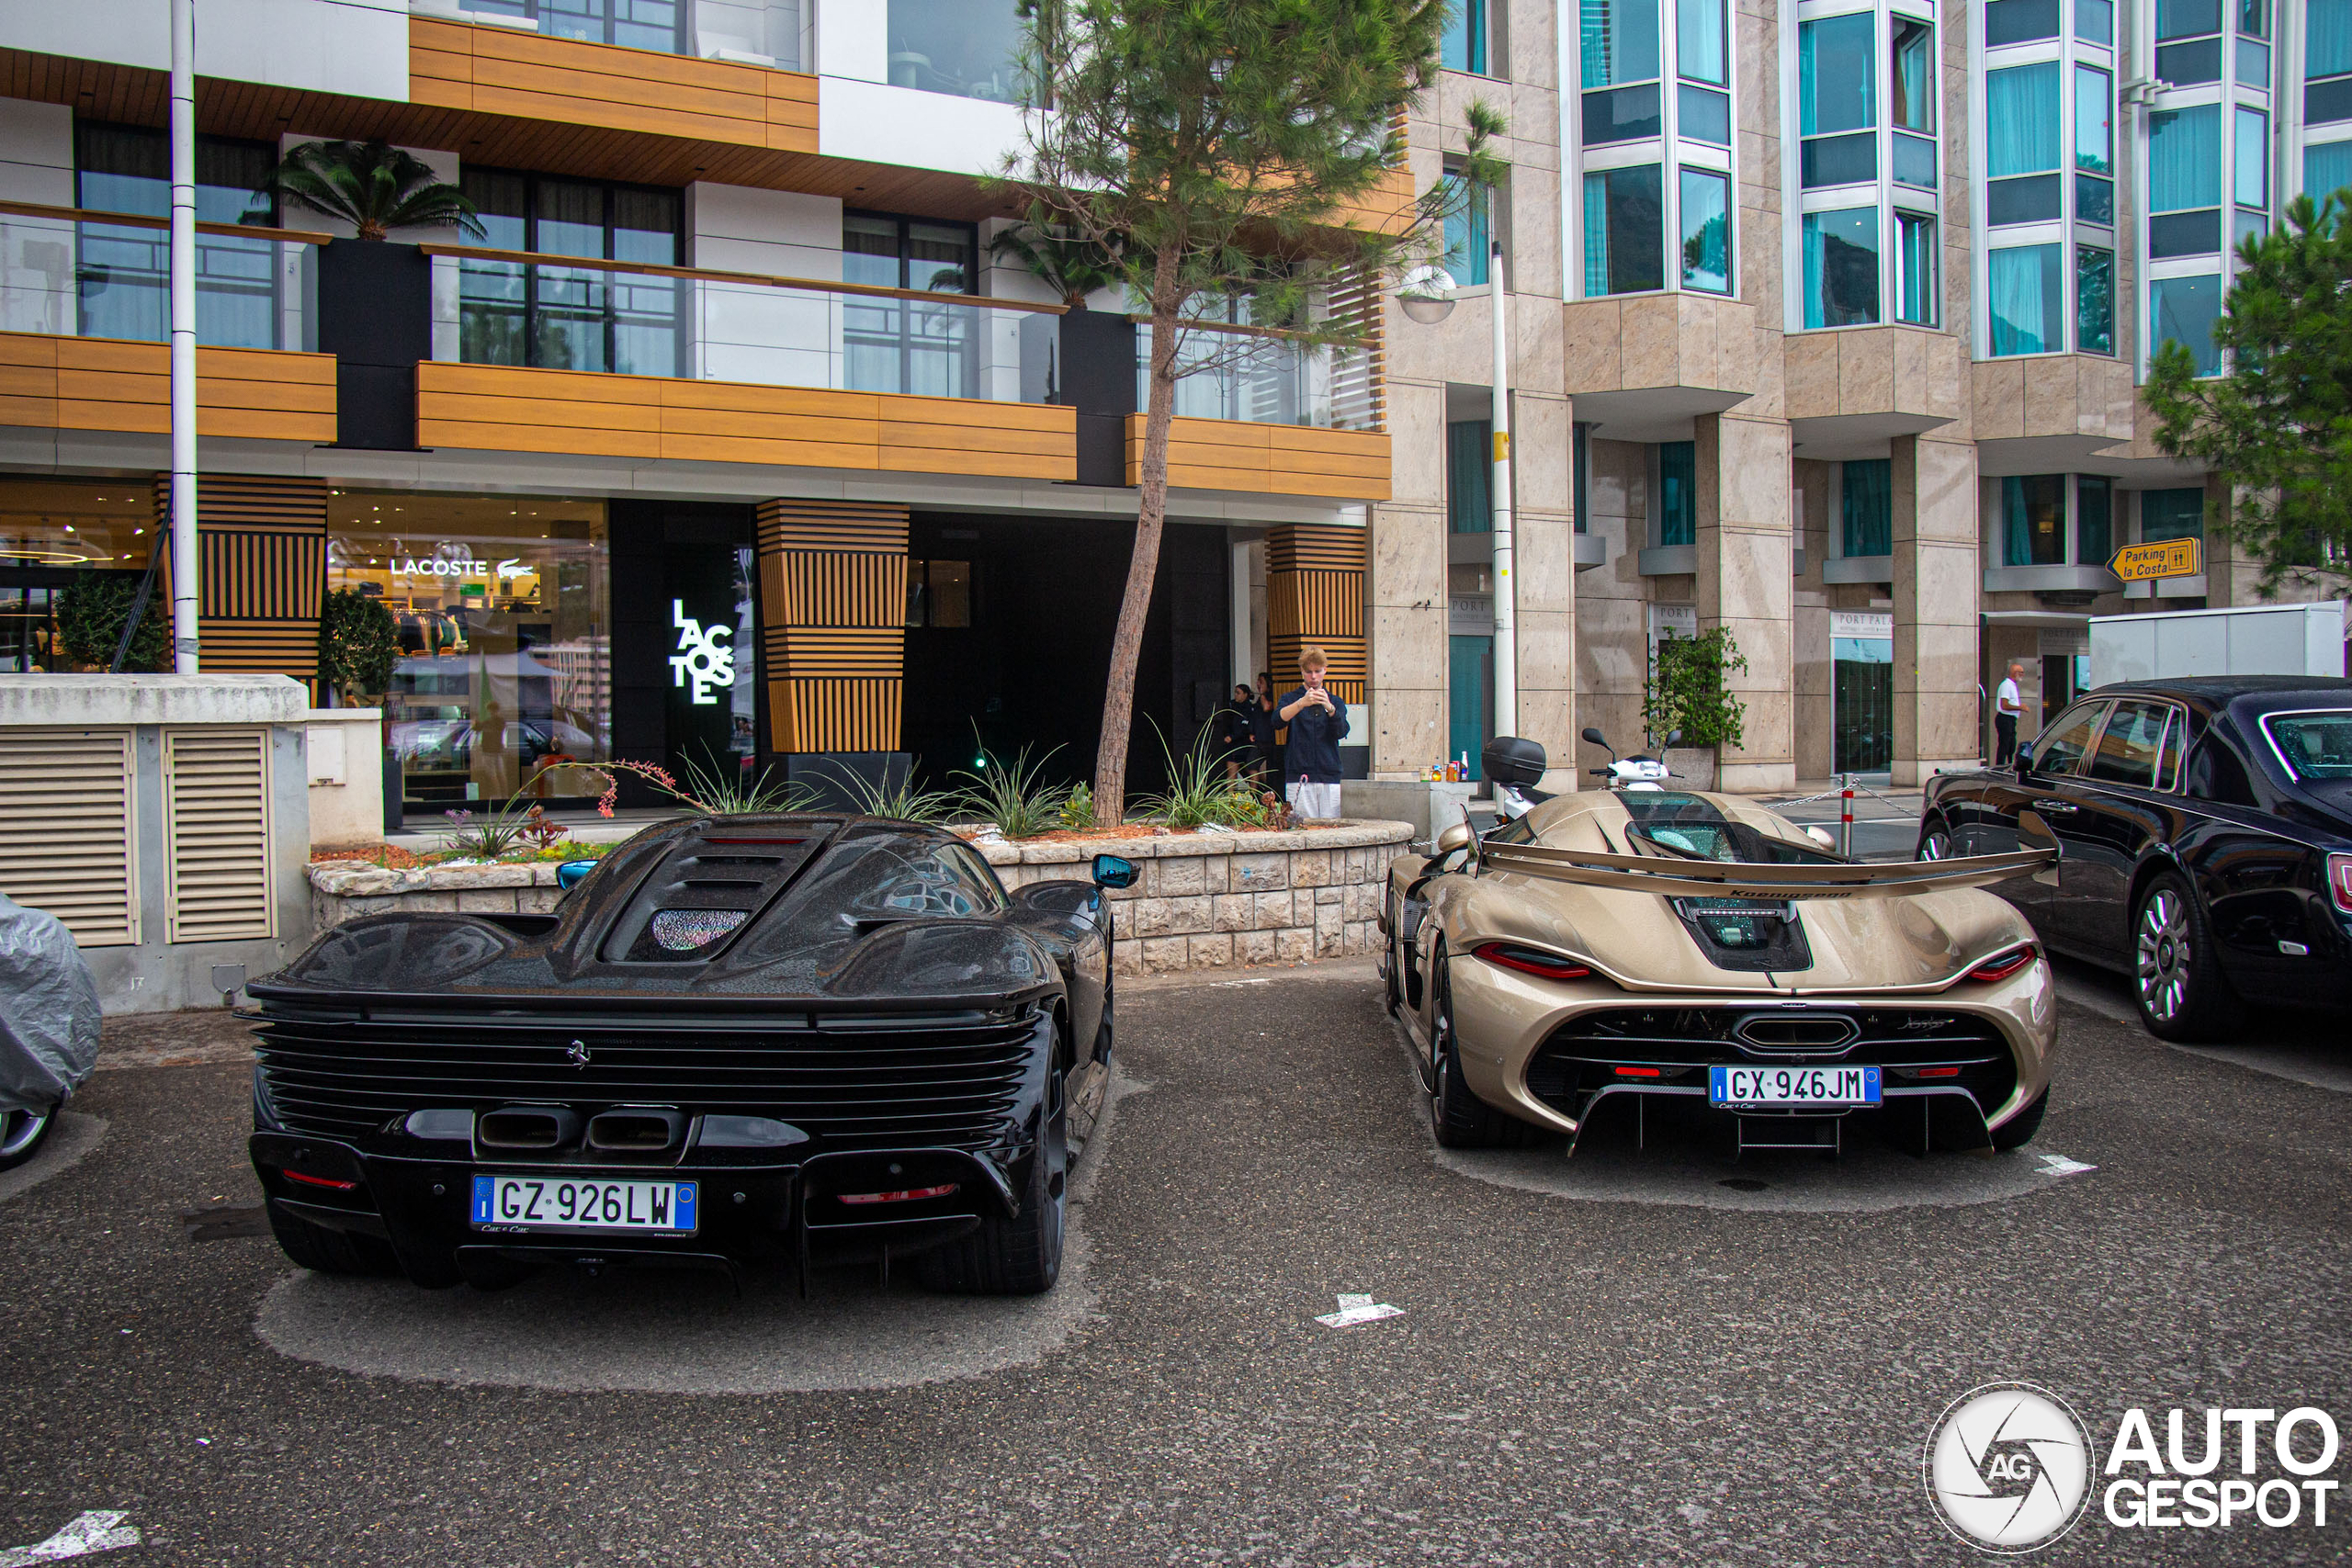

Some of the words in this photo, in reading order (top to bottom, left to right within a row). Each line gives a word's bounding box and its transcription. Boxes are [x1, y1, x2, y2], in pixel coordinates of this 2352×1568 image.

[2125, 549, 2165, 563] Parking
[390, 558, 488, 576] LACOSTE
[2123, 566, 2132, 578] la
[2136, 564, 2167, 576] Costa
[1452, 600, 1486, 612] PORT
[1660, 607, 1689, 618] PORT
[1839, 614, 1865, 625] PORT
[1732, 1070, 1766, 1099] GX
[1775, 1070, 1860, 1100] 946JM
[501, 1181, 545, 1220] GZ
[557, 1183, 671, 1224] 926LW
[481, 1224, 502, 1233] Car
[509, 1225, 530, 1234] Car
